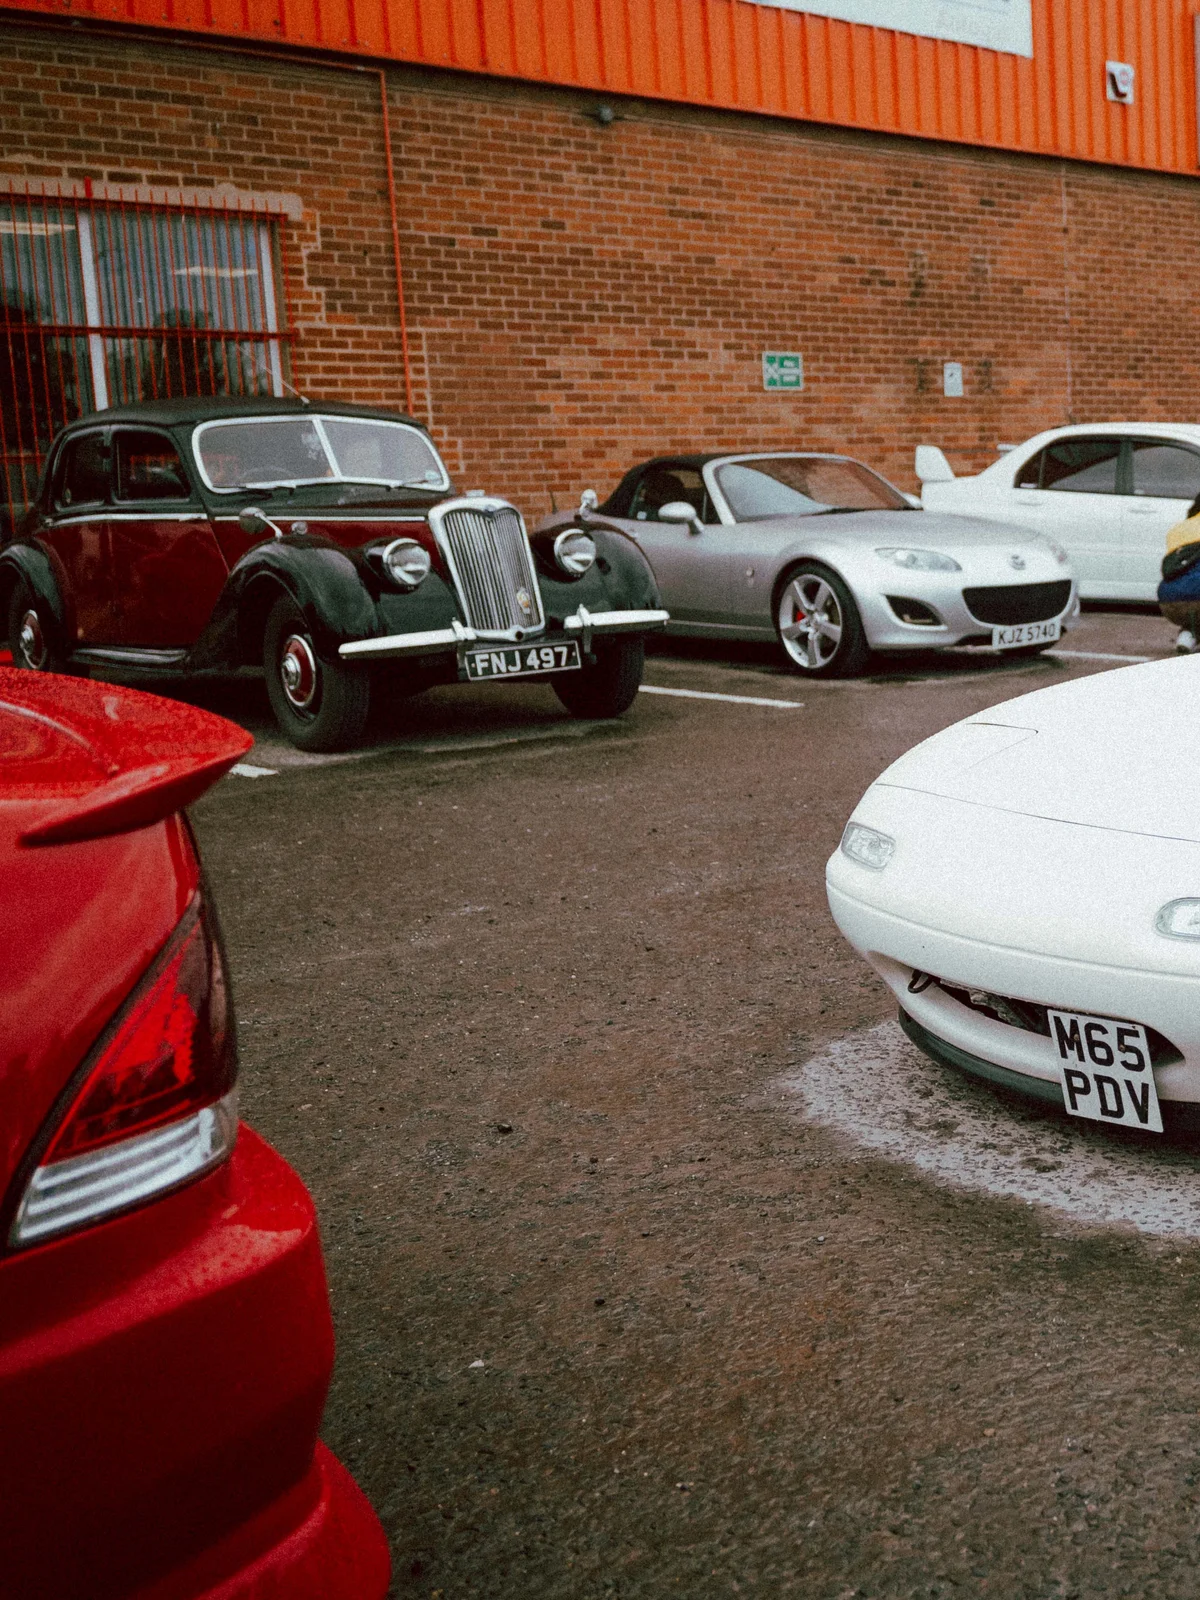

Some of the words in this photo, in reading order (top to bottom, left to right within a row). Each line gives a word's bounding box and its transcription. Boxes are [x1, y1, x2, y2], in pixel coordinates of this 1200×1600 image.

[999, 628, 1023, 644] KJZ
[1027, 623, 1056, 641] 5740
[475, 651, 522, 675] FNJ
[526, 646, 568, 670] 497
[1053, 1015, 1146, 1072] M65
[1063, 1067, 1149, 1125] PDV
